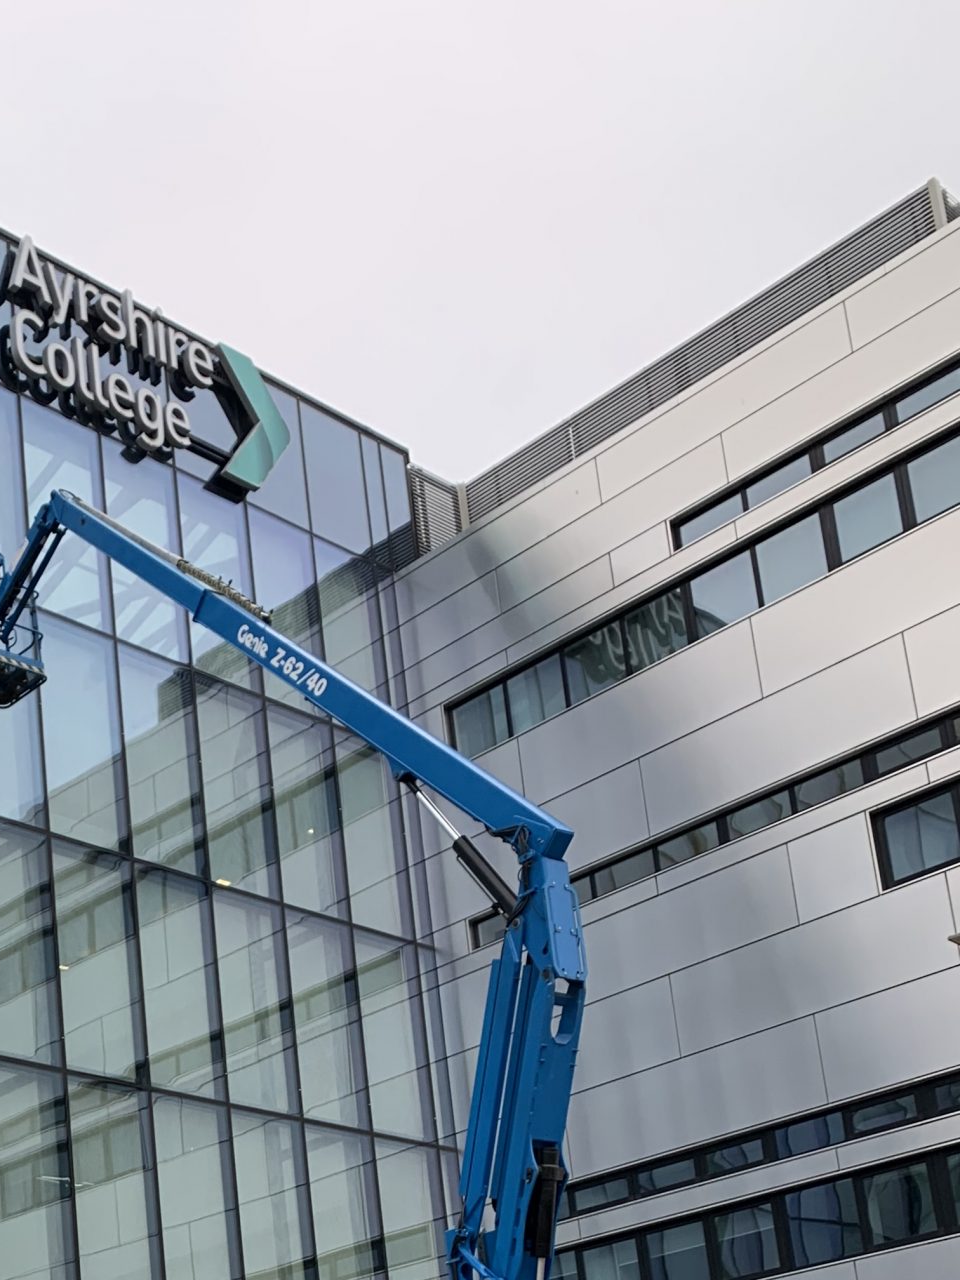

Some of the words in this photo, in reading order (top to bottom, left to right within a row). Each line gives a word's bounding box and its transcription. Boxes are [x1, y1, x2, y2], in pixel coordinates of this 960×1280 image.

[7, 234, 214, 389] Ayrshire
[9, 308, 192, 451] College
[237, 624, 269, 658] Genie
[270, 647, 328, 697] Z-62/40
